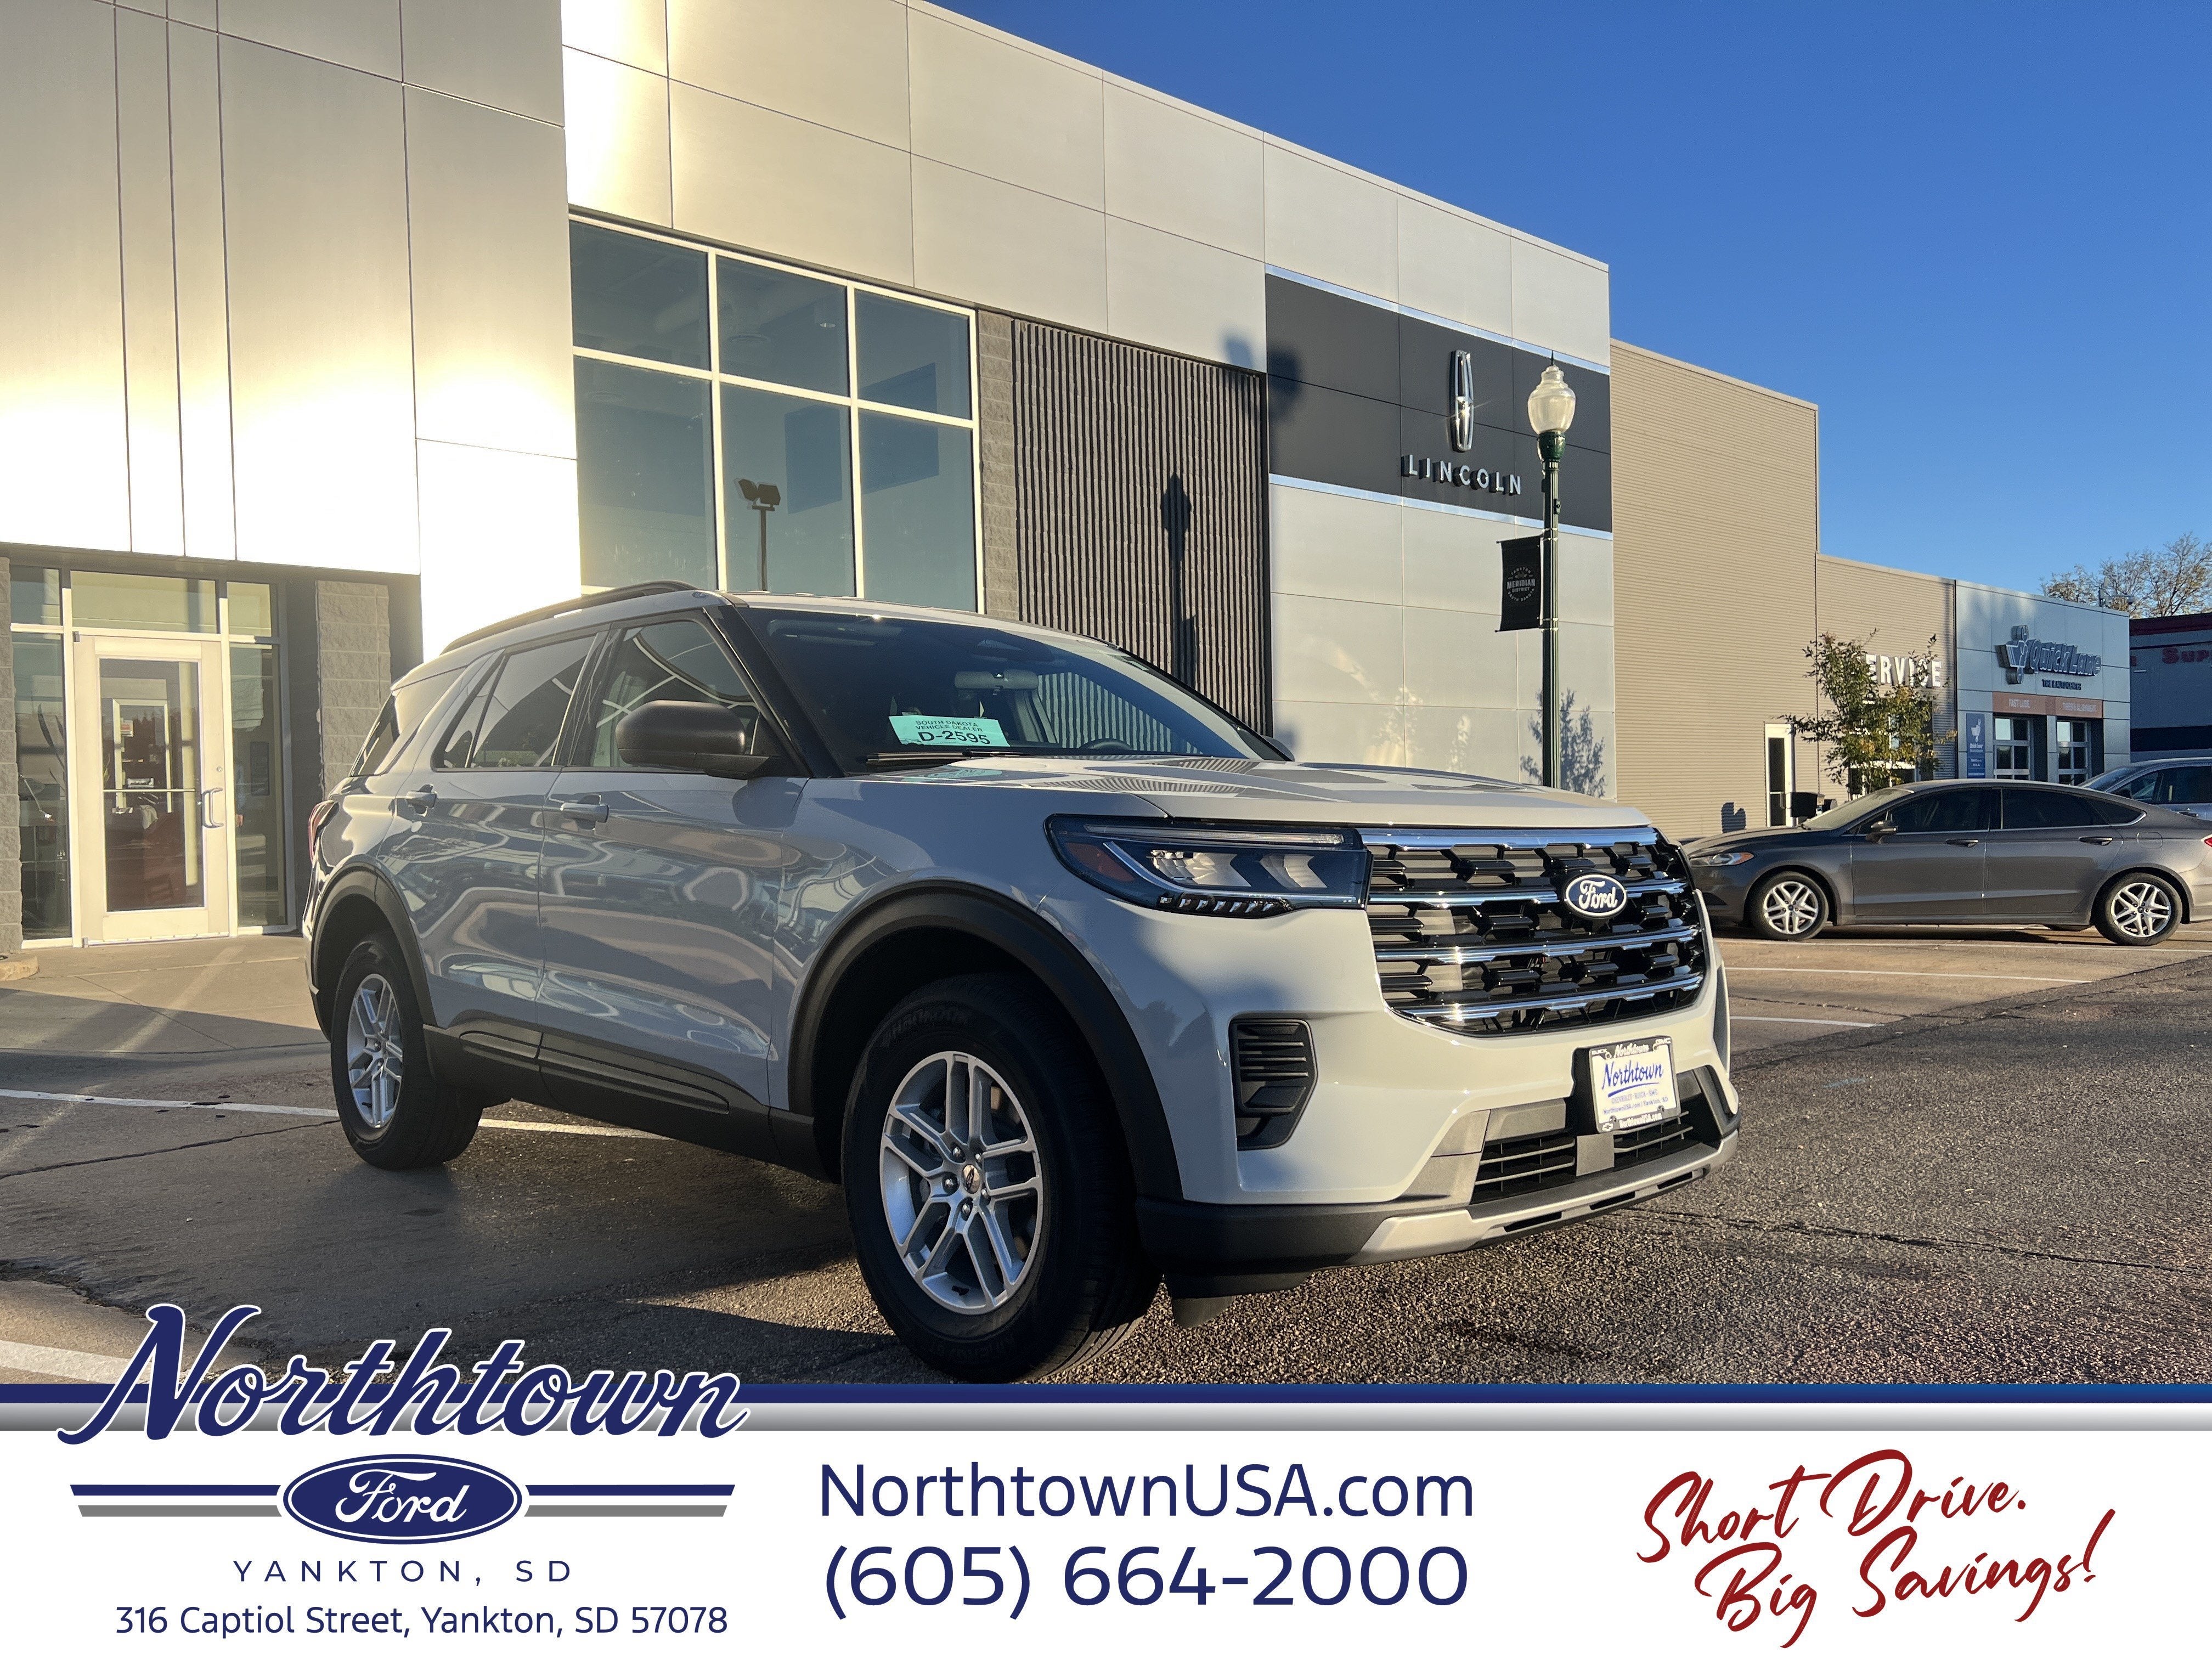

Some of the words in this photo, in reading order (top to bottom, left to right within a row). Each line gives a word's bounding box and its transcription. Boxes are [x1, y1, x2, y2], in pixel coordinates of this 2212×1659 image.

[1404, 454, 1521, 495] LINCOLN
[1507, 578, 1536, 590] MERIDIAN
[1864, 654, 1942, 687] ERVICE
[918, 730, 991, 745] D-2595
[1578, 880, 1618, 909] Ford
[1613, 1043, 1650, 1058] Northtown
[1601, 1060, 1664, 1090] Northtown
